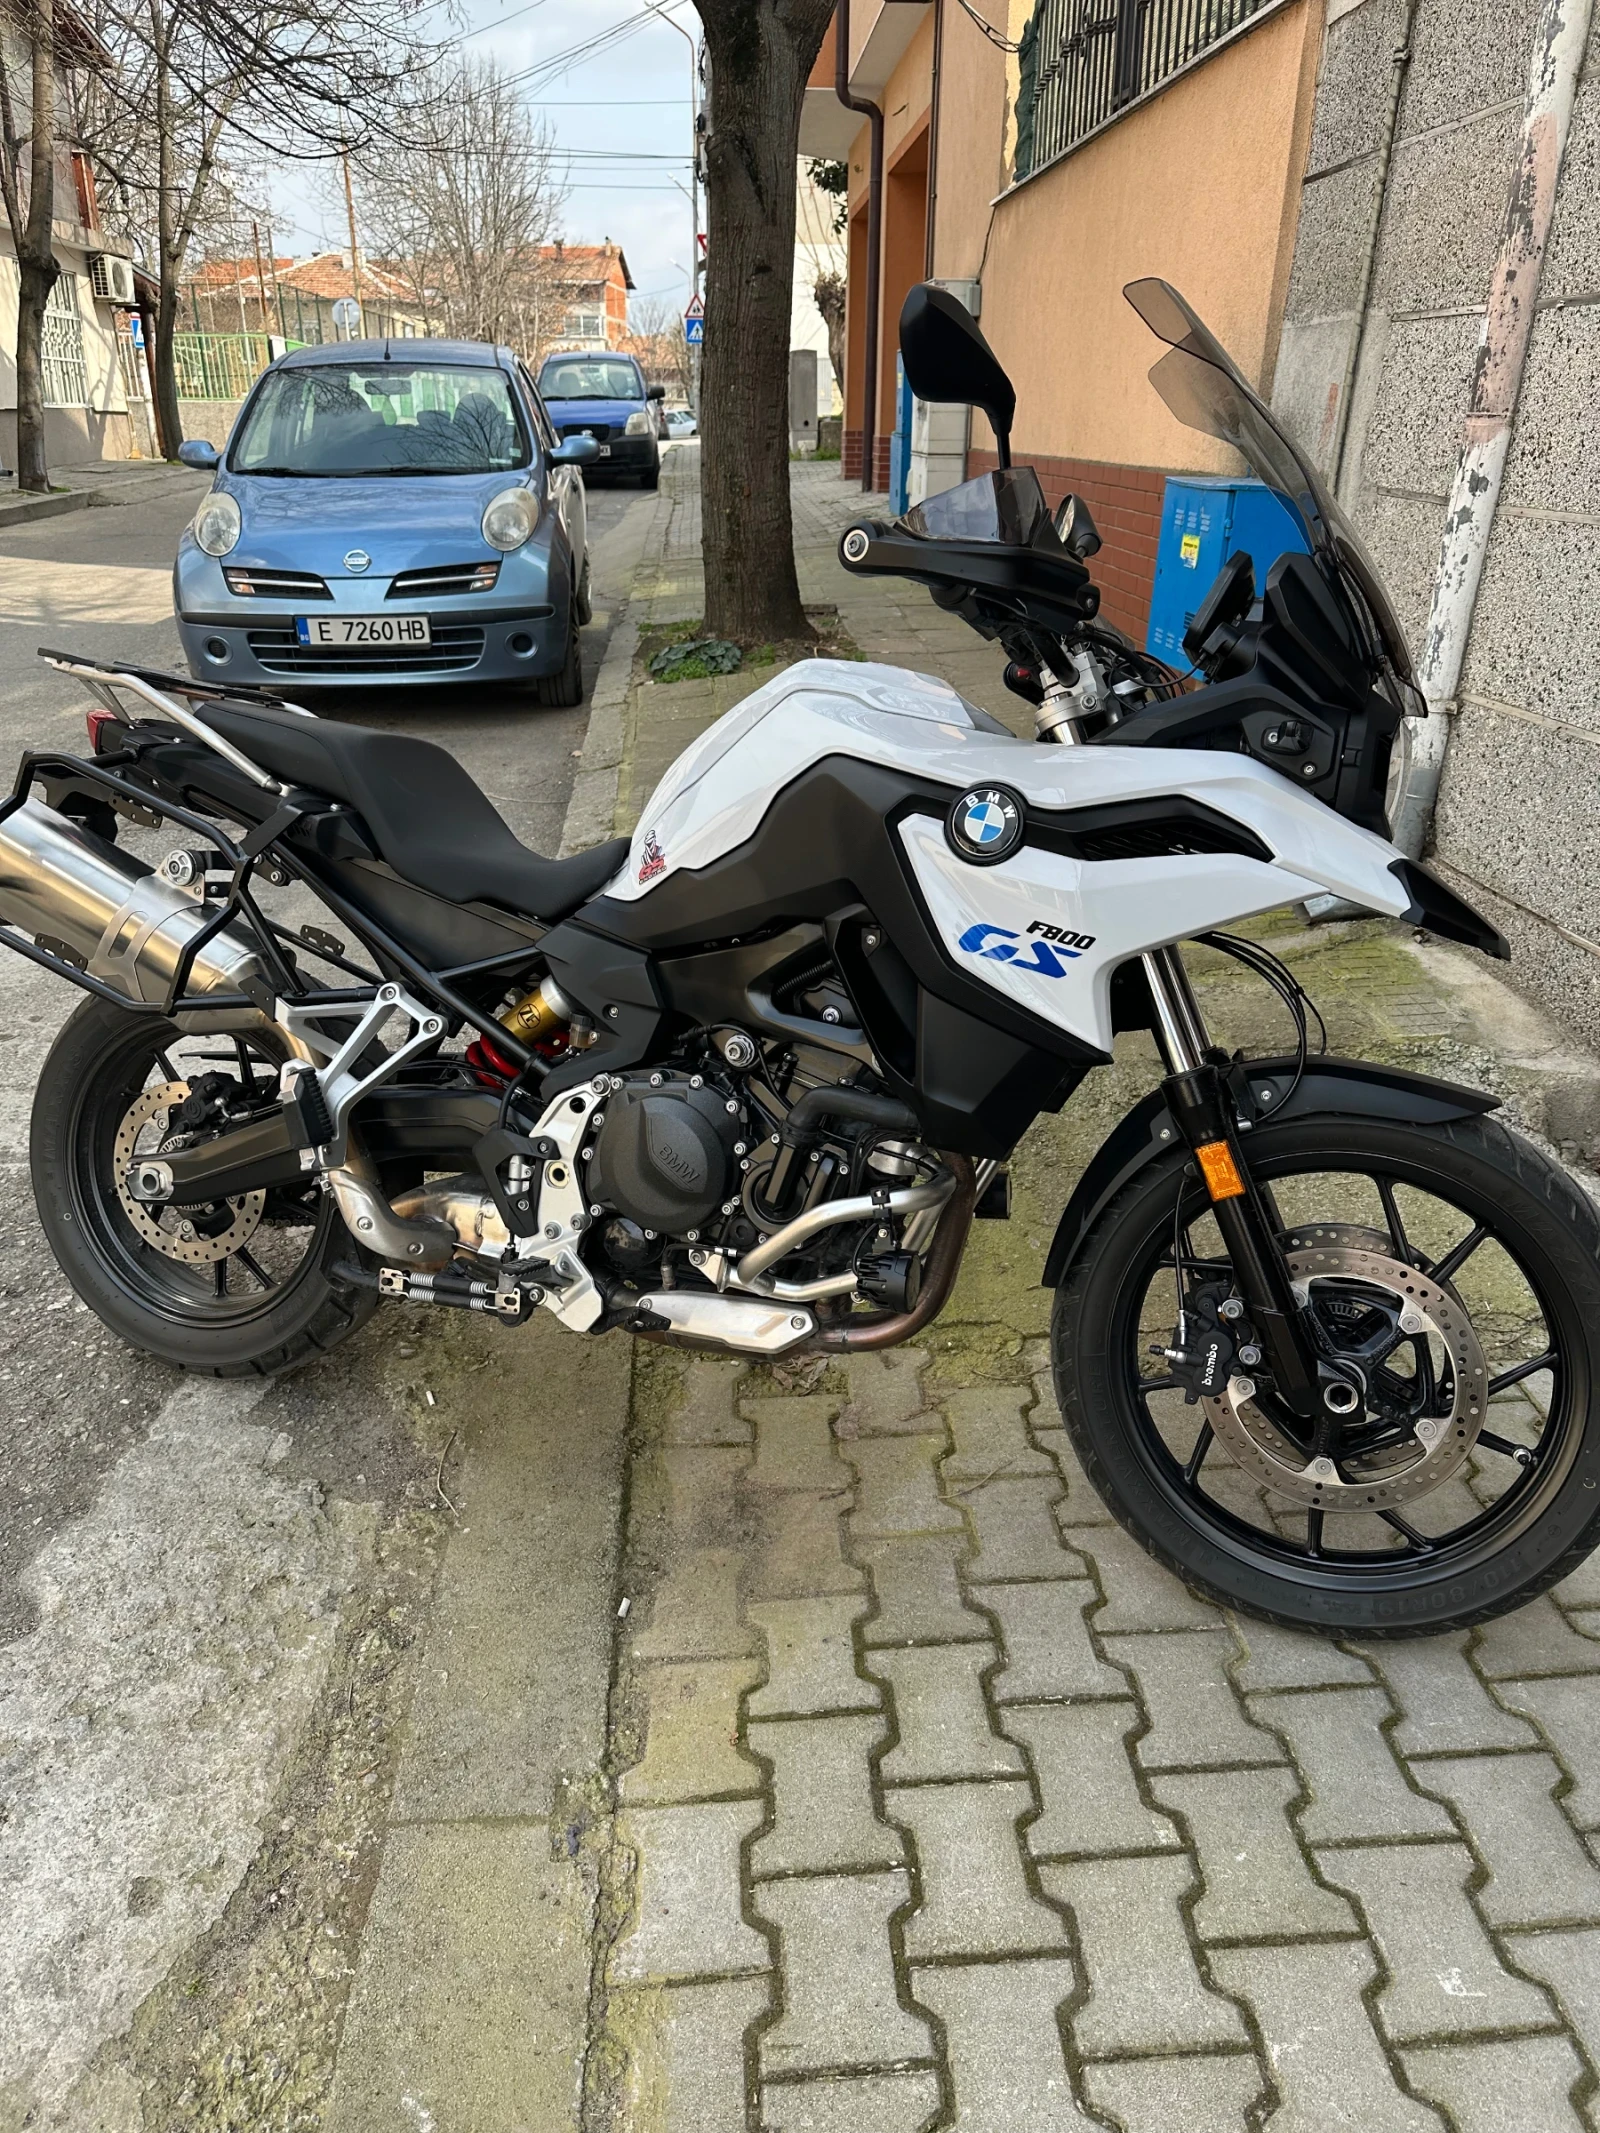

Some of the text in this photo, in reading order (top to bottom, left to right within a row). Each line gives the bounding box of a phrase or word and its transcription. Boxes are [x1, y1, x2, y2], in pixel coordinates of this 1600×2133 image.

[300, 633, 310, 642] BG
[318, 620, 425, 641] E 7260 HB
[965, 791, 1016, 819] BMW
[1026, 920, 1097, 950] F800
[958, 923, 1083, 978] GS
[517, 1003, 541, 1029] ZF
[660, 1143, 701, 1184] BMW
[1201, 1343, 1219, 1387] brembo
